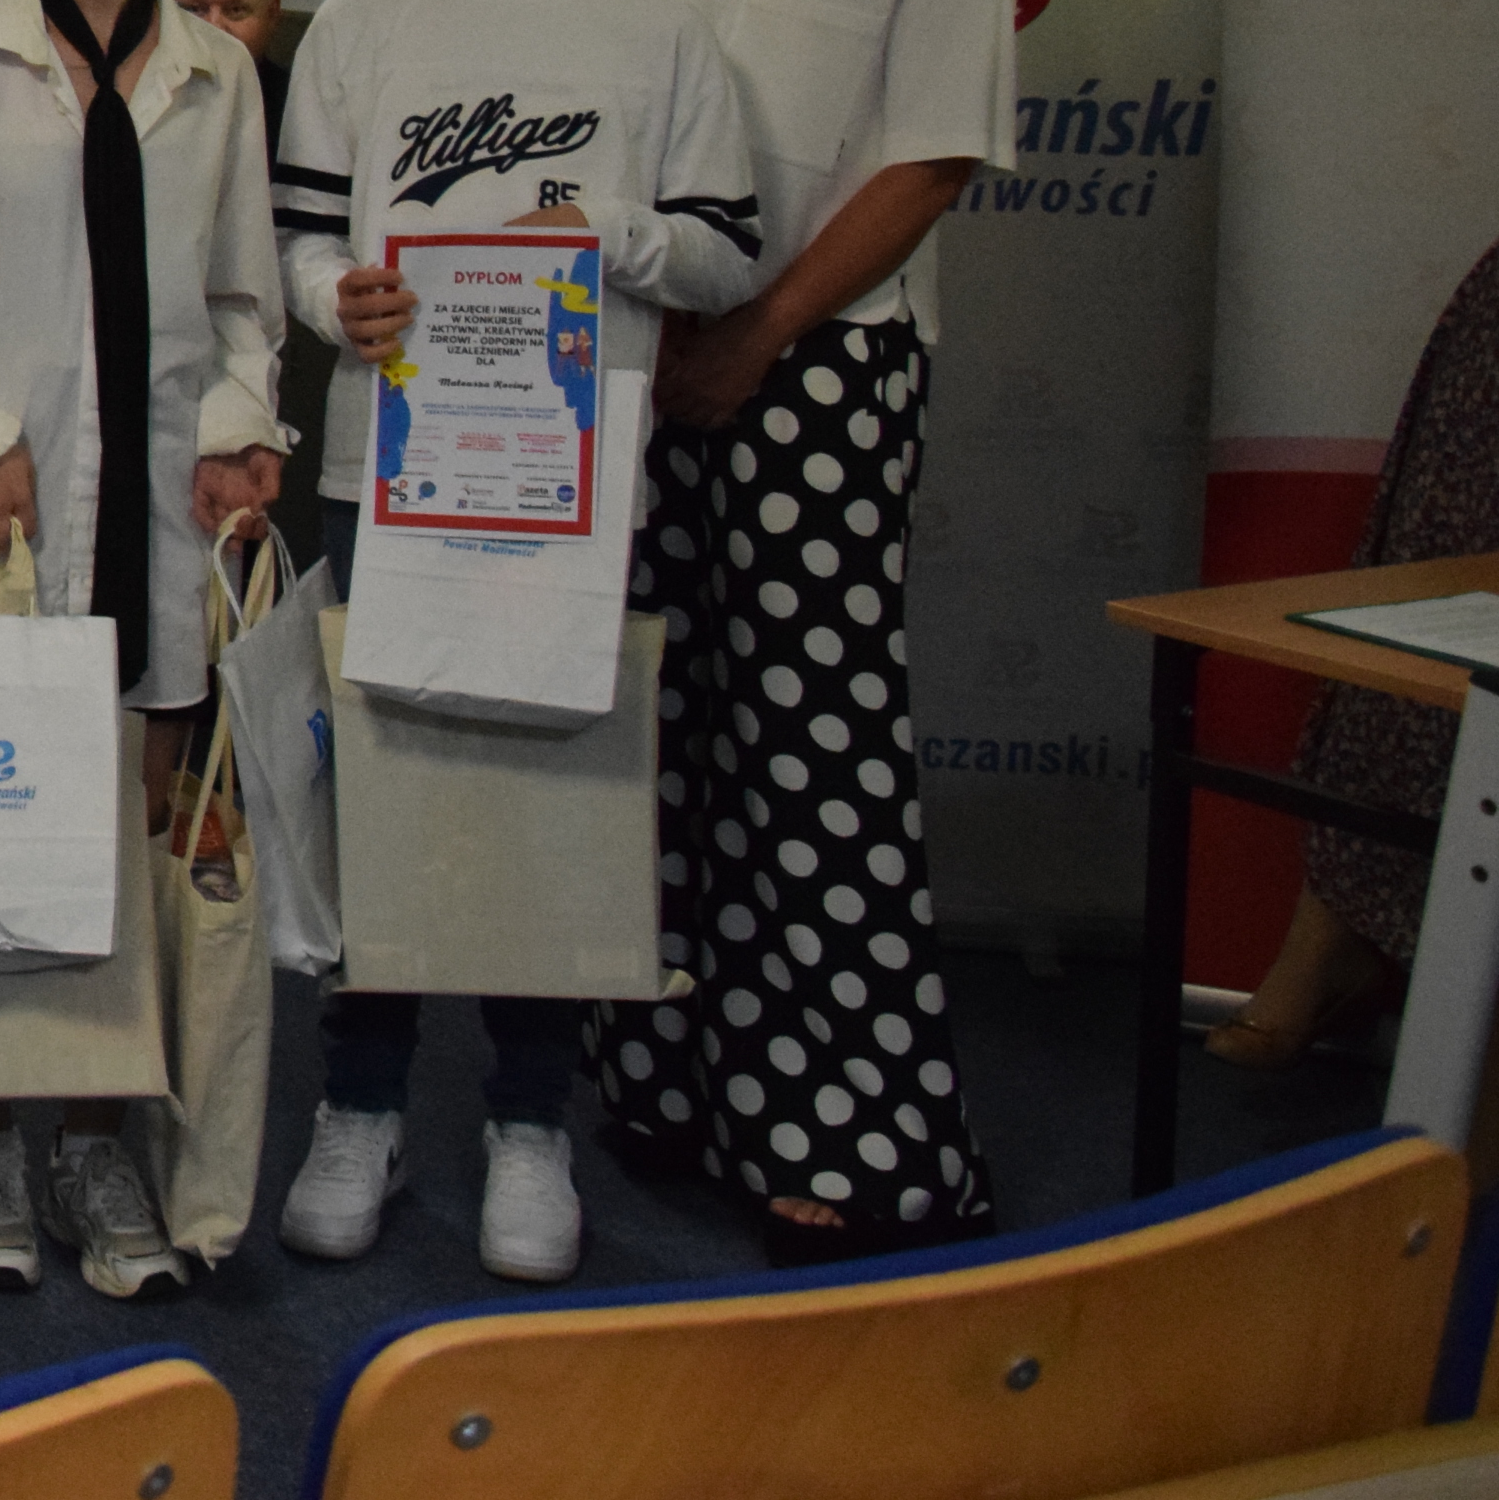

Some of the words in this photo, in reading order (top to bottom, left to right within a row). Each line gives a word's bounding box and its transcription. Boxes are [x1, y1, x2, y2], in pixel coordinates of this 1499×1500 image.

[1014, 78, 1218, 157] ański
[391, 93, 600, 180] Hilfiger
[454, 271, 522, 285] DYPLOM
[434, 305, 447, 313] ZA
[452, 305, 490, 316] ZAJĘCIE
[499, 306, 541, 315] MIEJSCA
[452, 315, 462, 324] W
[465, 316, 522, 325] KONKURSIE
[429, 335, 470, 344] ZDROWI
[480, 336, 527, 346] ODPORNI
[530, 337, 544, 347] NA
[476, 357, 495, 366] DLA
